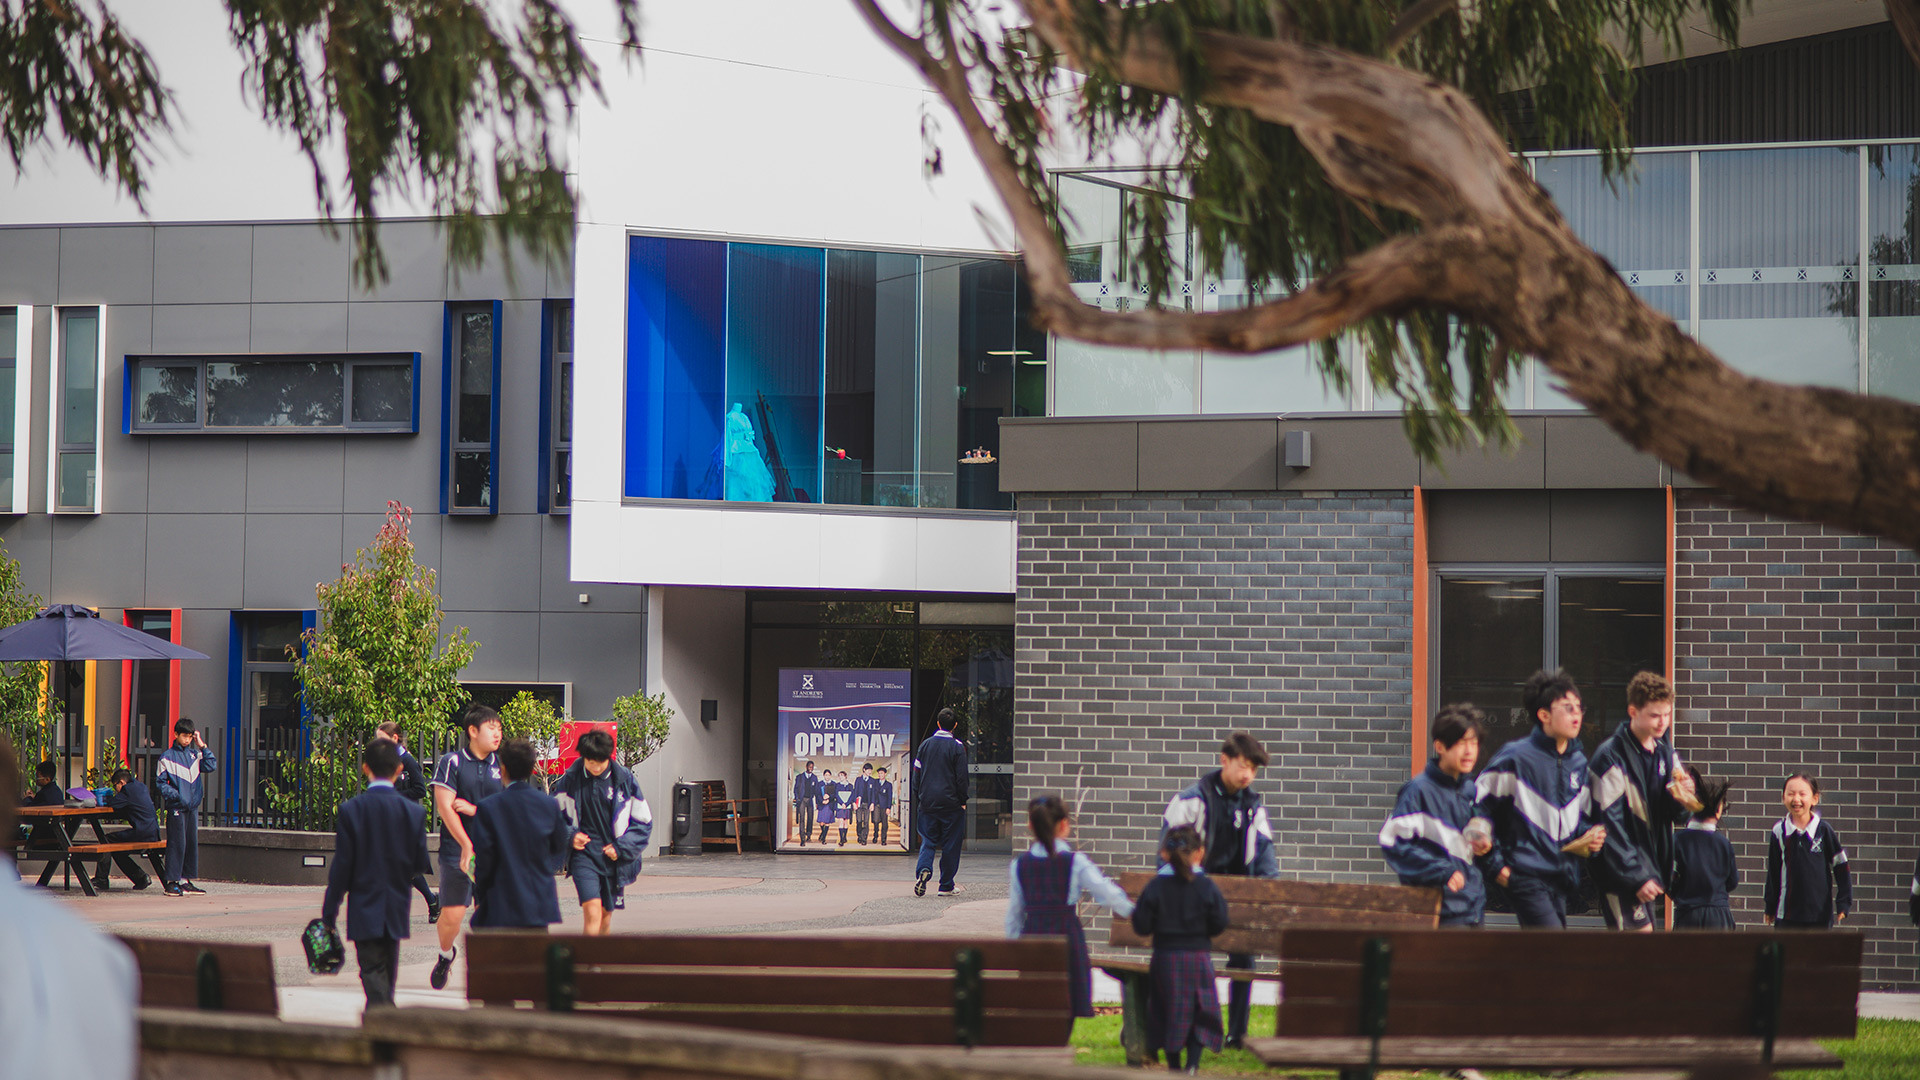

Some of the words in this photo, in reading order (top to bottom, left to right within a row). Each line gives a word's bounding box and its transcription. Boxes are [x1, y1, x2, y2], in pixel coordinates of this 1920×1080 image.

[809, 717, 881, 730] WELCOME
[794, 732, 849, 756] OPEN
[854, 733, 895, 757] DAY
